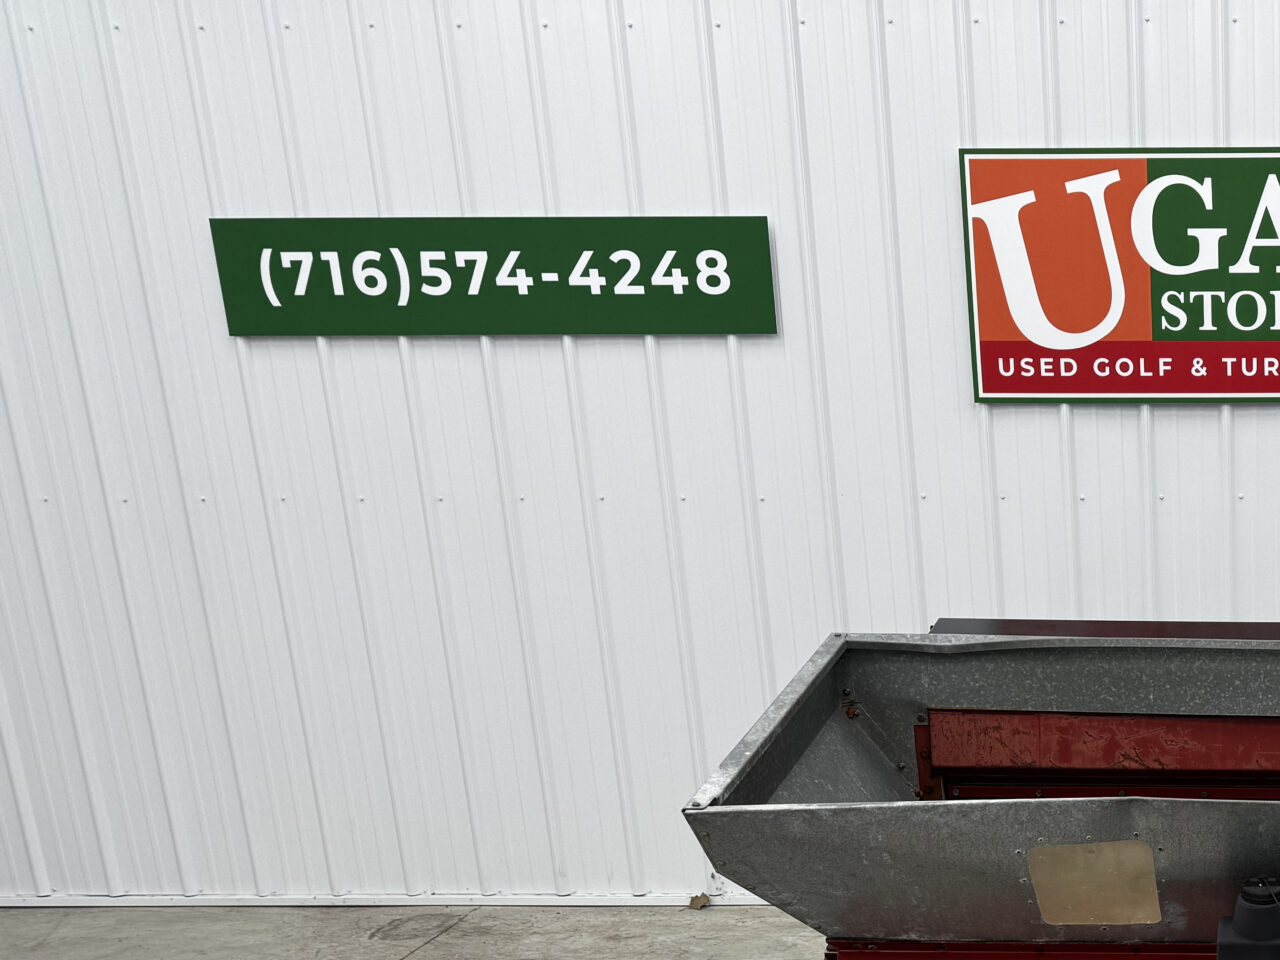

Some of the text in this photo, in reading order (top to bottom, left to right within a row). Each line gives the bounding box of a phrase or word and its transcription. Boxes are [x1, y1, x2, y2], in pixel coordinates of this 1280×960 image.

[259, 247, 731, 307] (716)574-4248
[998, 356, 1078, 377] USED
[1092, 356, 1173, 377] GOLF
[1190, 356, 1208, 377] &
